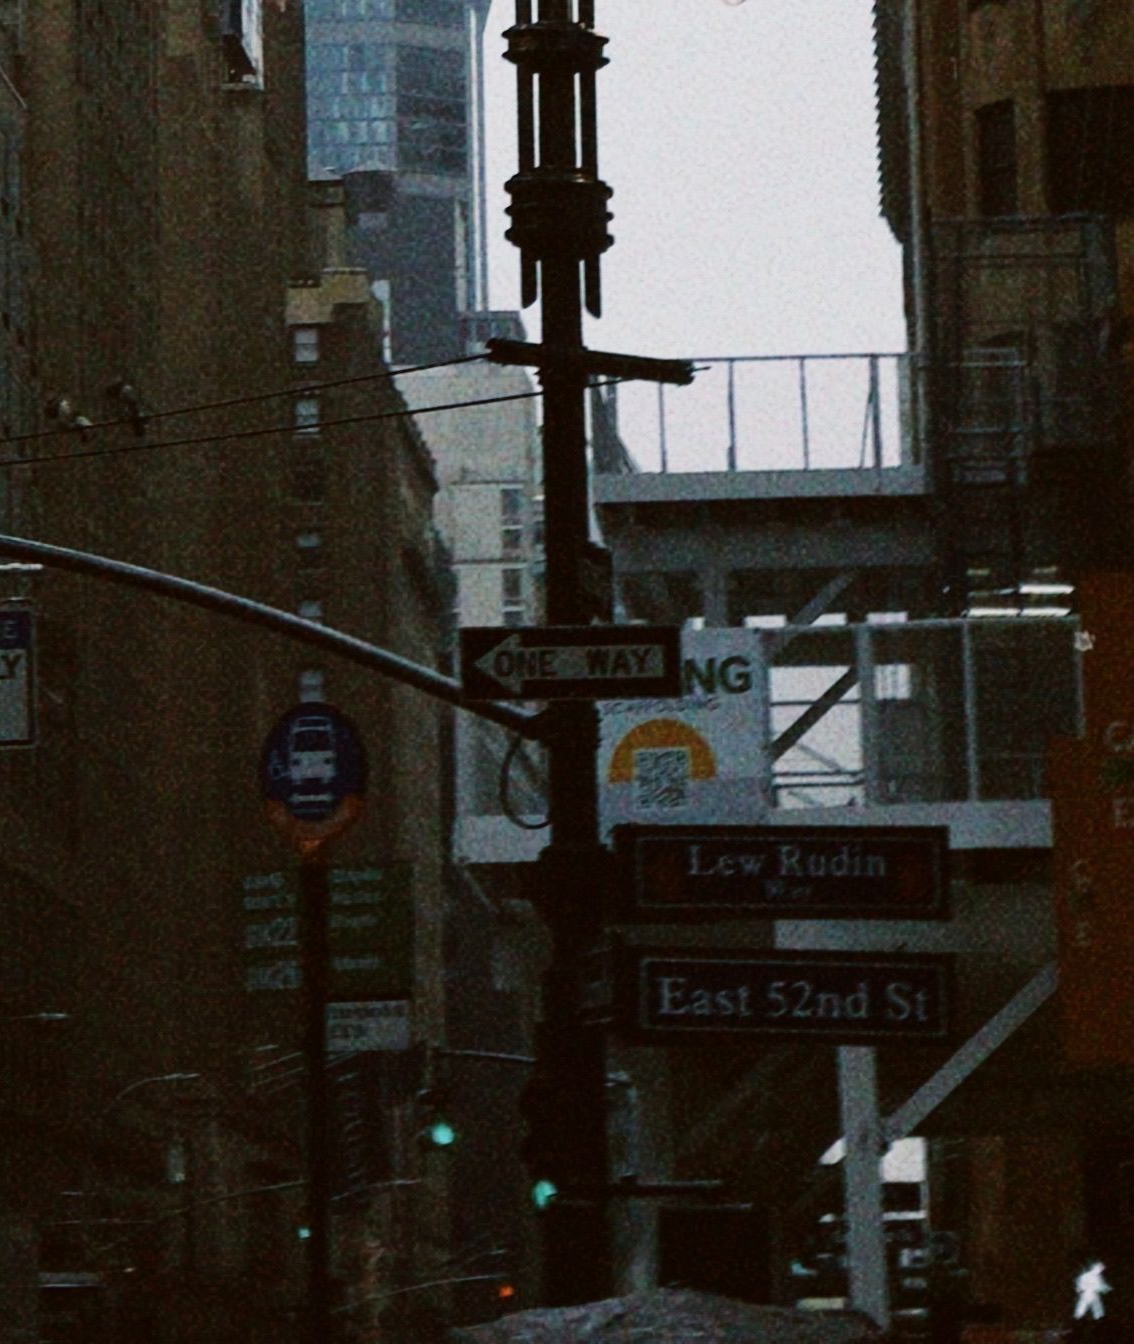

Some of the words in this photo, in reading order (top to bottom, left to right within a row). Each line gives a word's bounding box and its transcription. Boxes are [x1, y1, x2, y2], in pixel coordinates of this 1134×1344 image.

[493, 649, 557, 679] ONE
[586, 647, 652, 675] WAY
[682, 655, 752, 694] NG
[687, 843, 766, 877] Lew
[778, 843, 887, 877] Rudin
[656, 976, 753, 1017] East
[765, 979, 871, 1020] 52nd
[884, 981, 930, 1022] St
